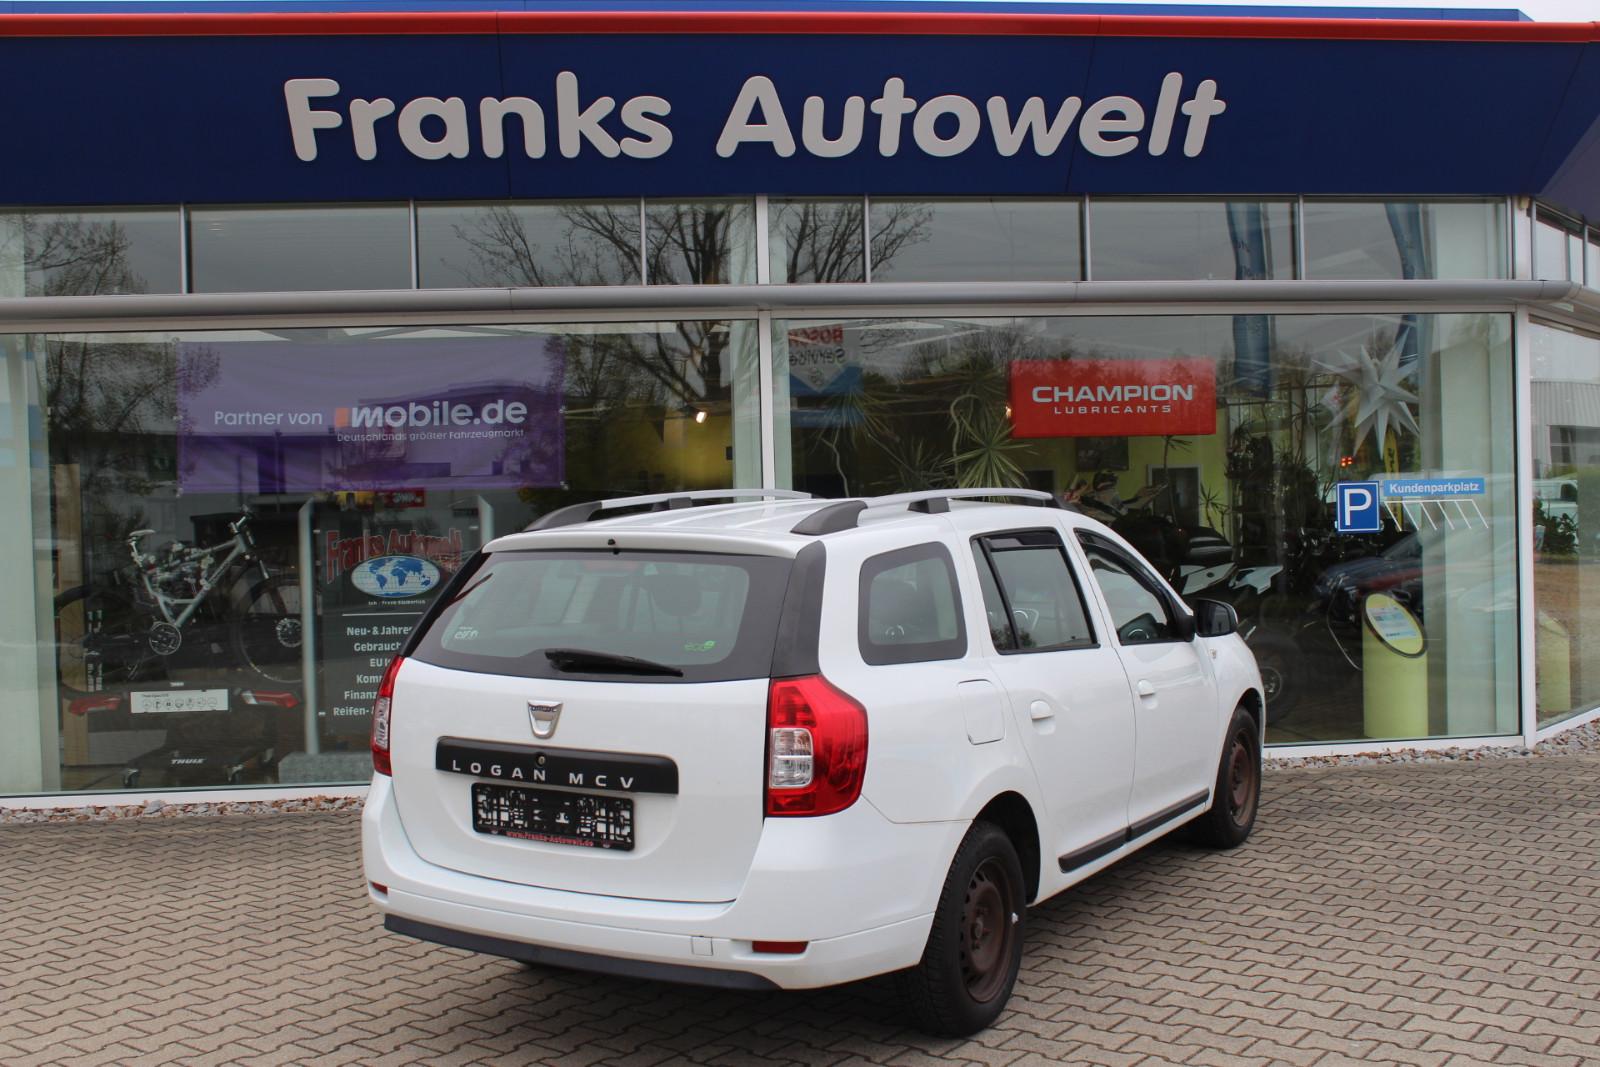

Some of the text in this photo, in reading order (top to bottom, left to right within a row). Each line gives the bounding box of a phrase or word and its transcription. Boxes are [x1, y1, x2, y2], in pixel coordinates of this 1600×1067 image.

[284, 71, 1227, 162] Franks Autowelt
[1032, 385, 1193, 403] CHAMPION
[214, 400, 528, 428] Partner von mobile.de
[1054, 405, 1171, 415] LUBRICANTS
[336, 432, 407, 442] Deutschlands
[448, 428, 524, 440] Fahrzeugmarkt
[1389, 482, 1480, 495] Kundenparkplatz
[1343, 488, 1372, 526] P
[346, 626, 371, 636] Neu-
[372, 626, 379, 636] &
[369, 658, 383, 667] EU
[333, 706, 370, 716] Reifen-
[451, 760, 634, 789] LOGAN MCV
